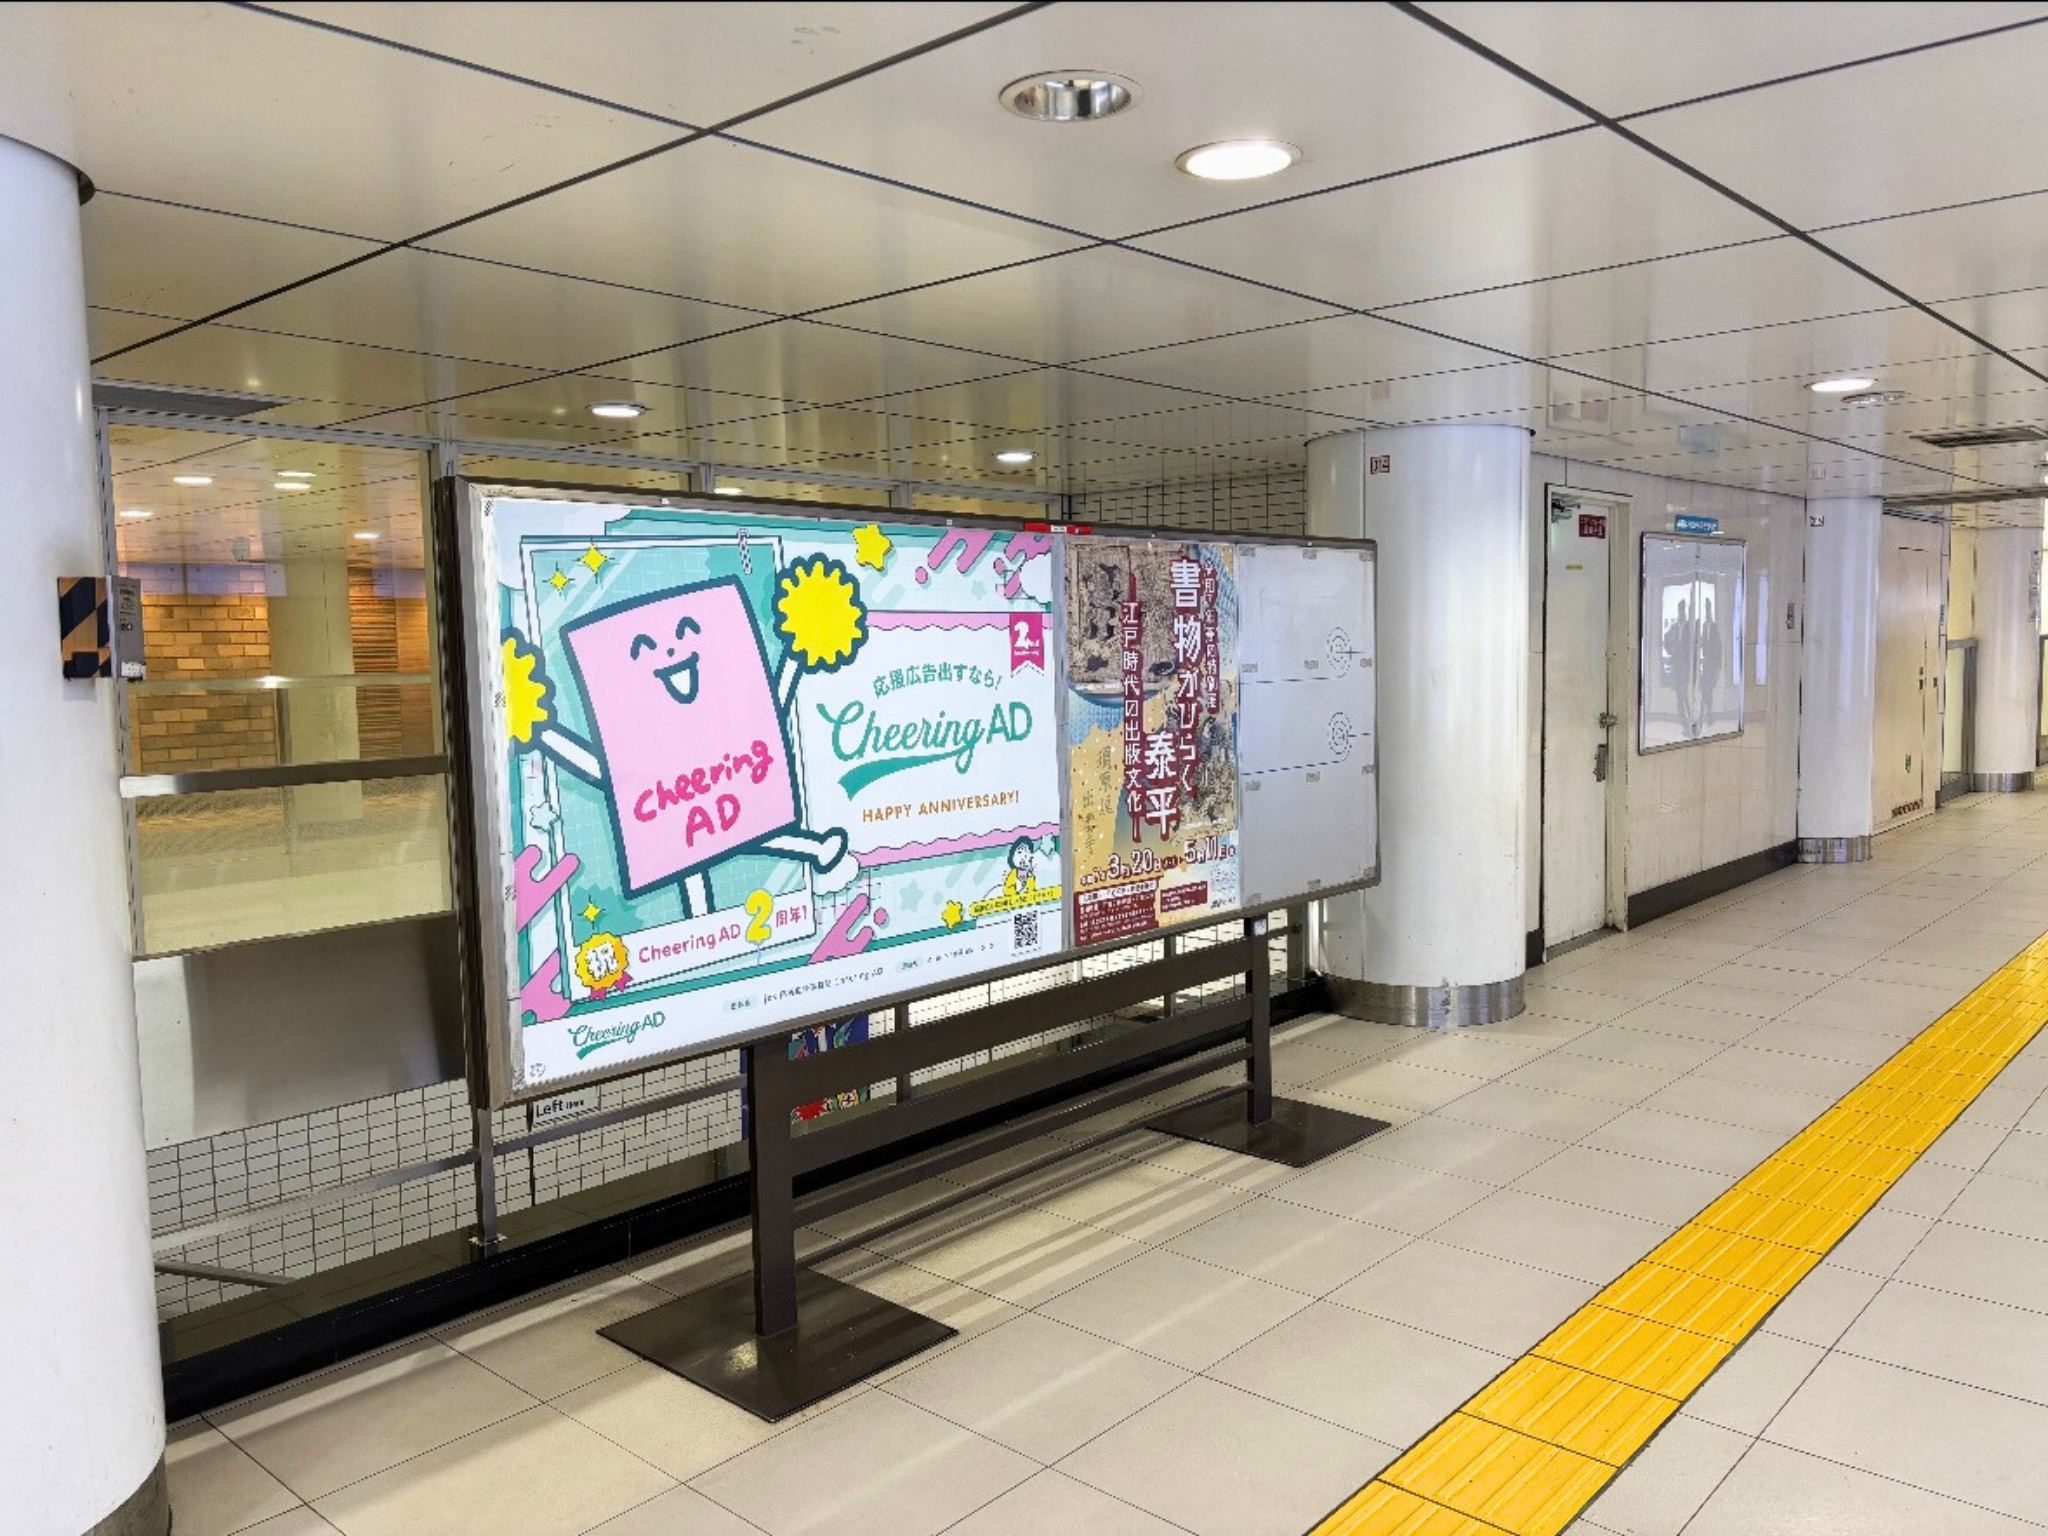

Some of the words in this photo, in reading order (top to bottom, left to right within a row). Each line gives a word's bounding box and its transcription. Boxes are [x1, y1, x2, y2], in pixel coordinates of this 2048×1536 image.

[1170, 558, 1201, 792] 書物がひらく
[816, 700, 985, 774] Cheering
[986, 701, 1033, 744] AD
[634, 739, 774, 823] Cheering
[862, 803, 912, 825] HAPPY
[918, 790, 1020, 816] ANNIVERSARY!
[1144, 730, 1177, 836] 泰平
[685, 793, 741, 849] AD
[638, 933, 717, 964] Cheering
[718, 923, 742, 943] AD
[641, 1010, 667, 1030] AD
[535, 1099, 564, 1118] Left
